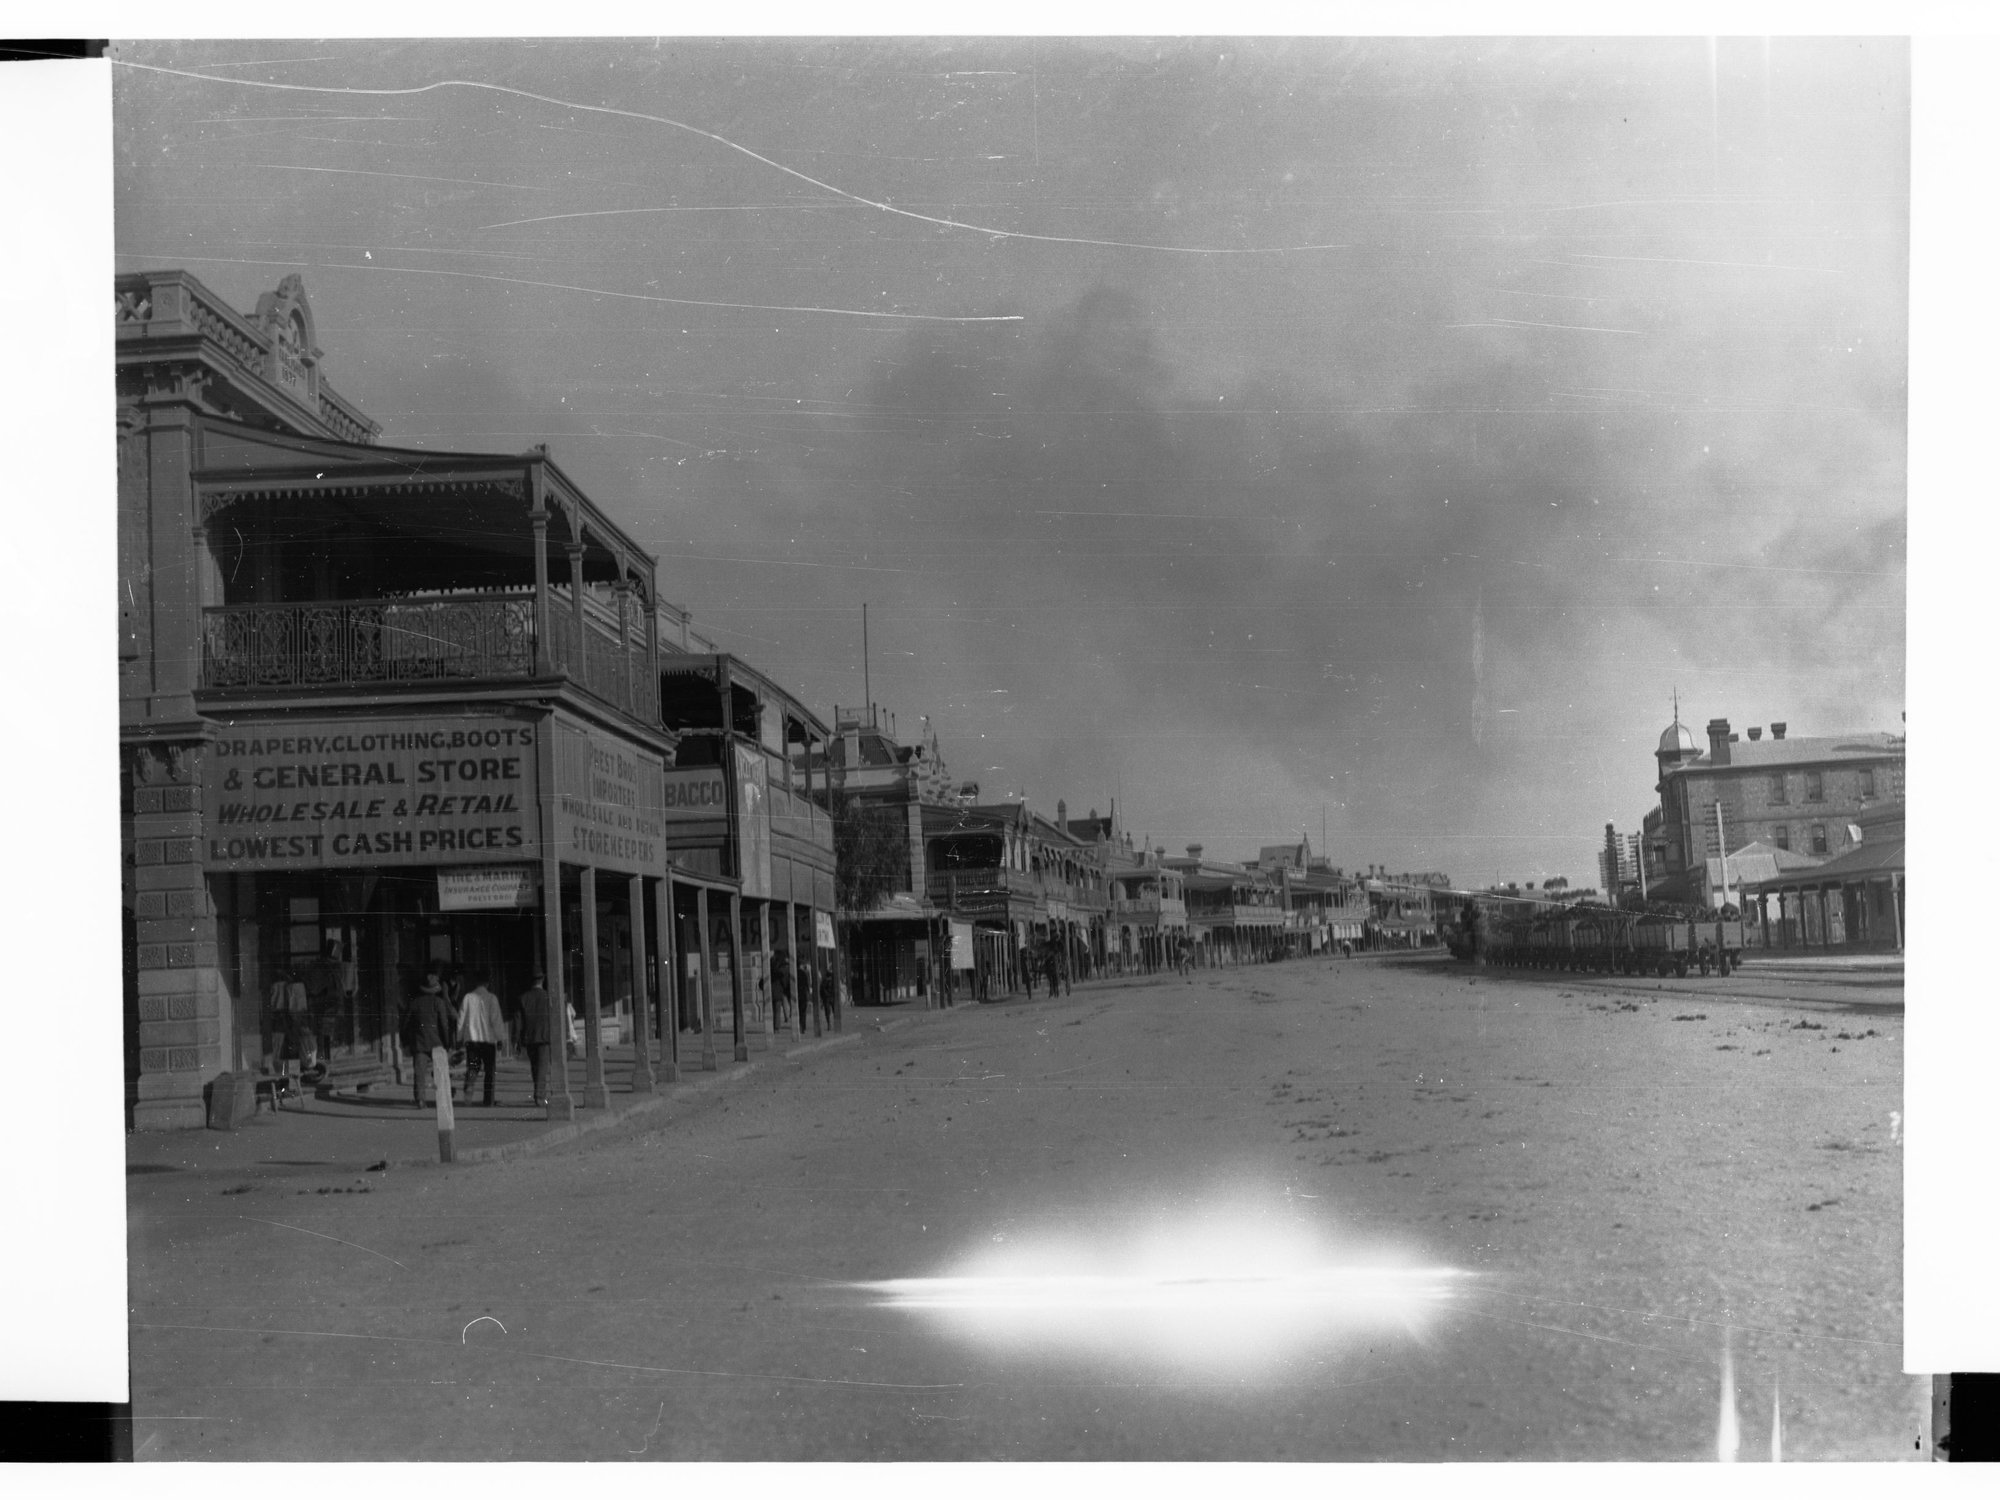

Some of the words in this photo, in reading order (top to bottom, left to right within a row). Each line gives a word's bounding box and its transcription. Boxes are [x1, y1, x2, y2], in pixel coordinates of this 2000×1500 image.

[452, 728, 532, 748] BOOTS
[224, 768, 243, 791] &
[253, 762, 405, 789] GENERAL
[417, 757, 521, 783] STORE
[593, 774, 636, 811] IMPORTERS
[665, 781, 724, 807] BACCO
[218, 800, 386, 824] WHOLESALE
[393, 798, 408, 817] &
[415, 794, 519, 817] RETAIL
[562, 800, 614, 826] WHOLESALE
[618, 815, 632, 830] AND
[210, 834, 325, 861] LOWEST
[332, 831, 412, 855] CASH
[573, 826, 655, 863] STOREKEEPERS
[483, 870, 529, 882] MARINE
